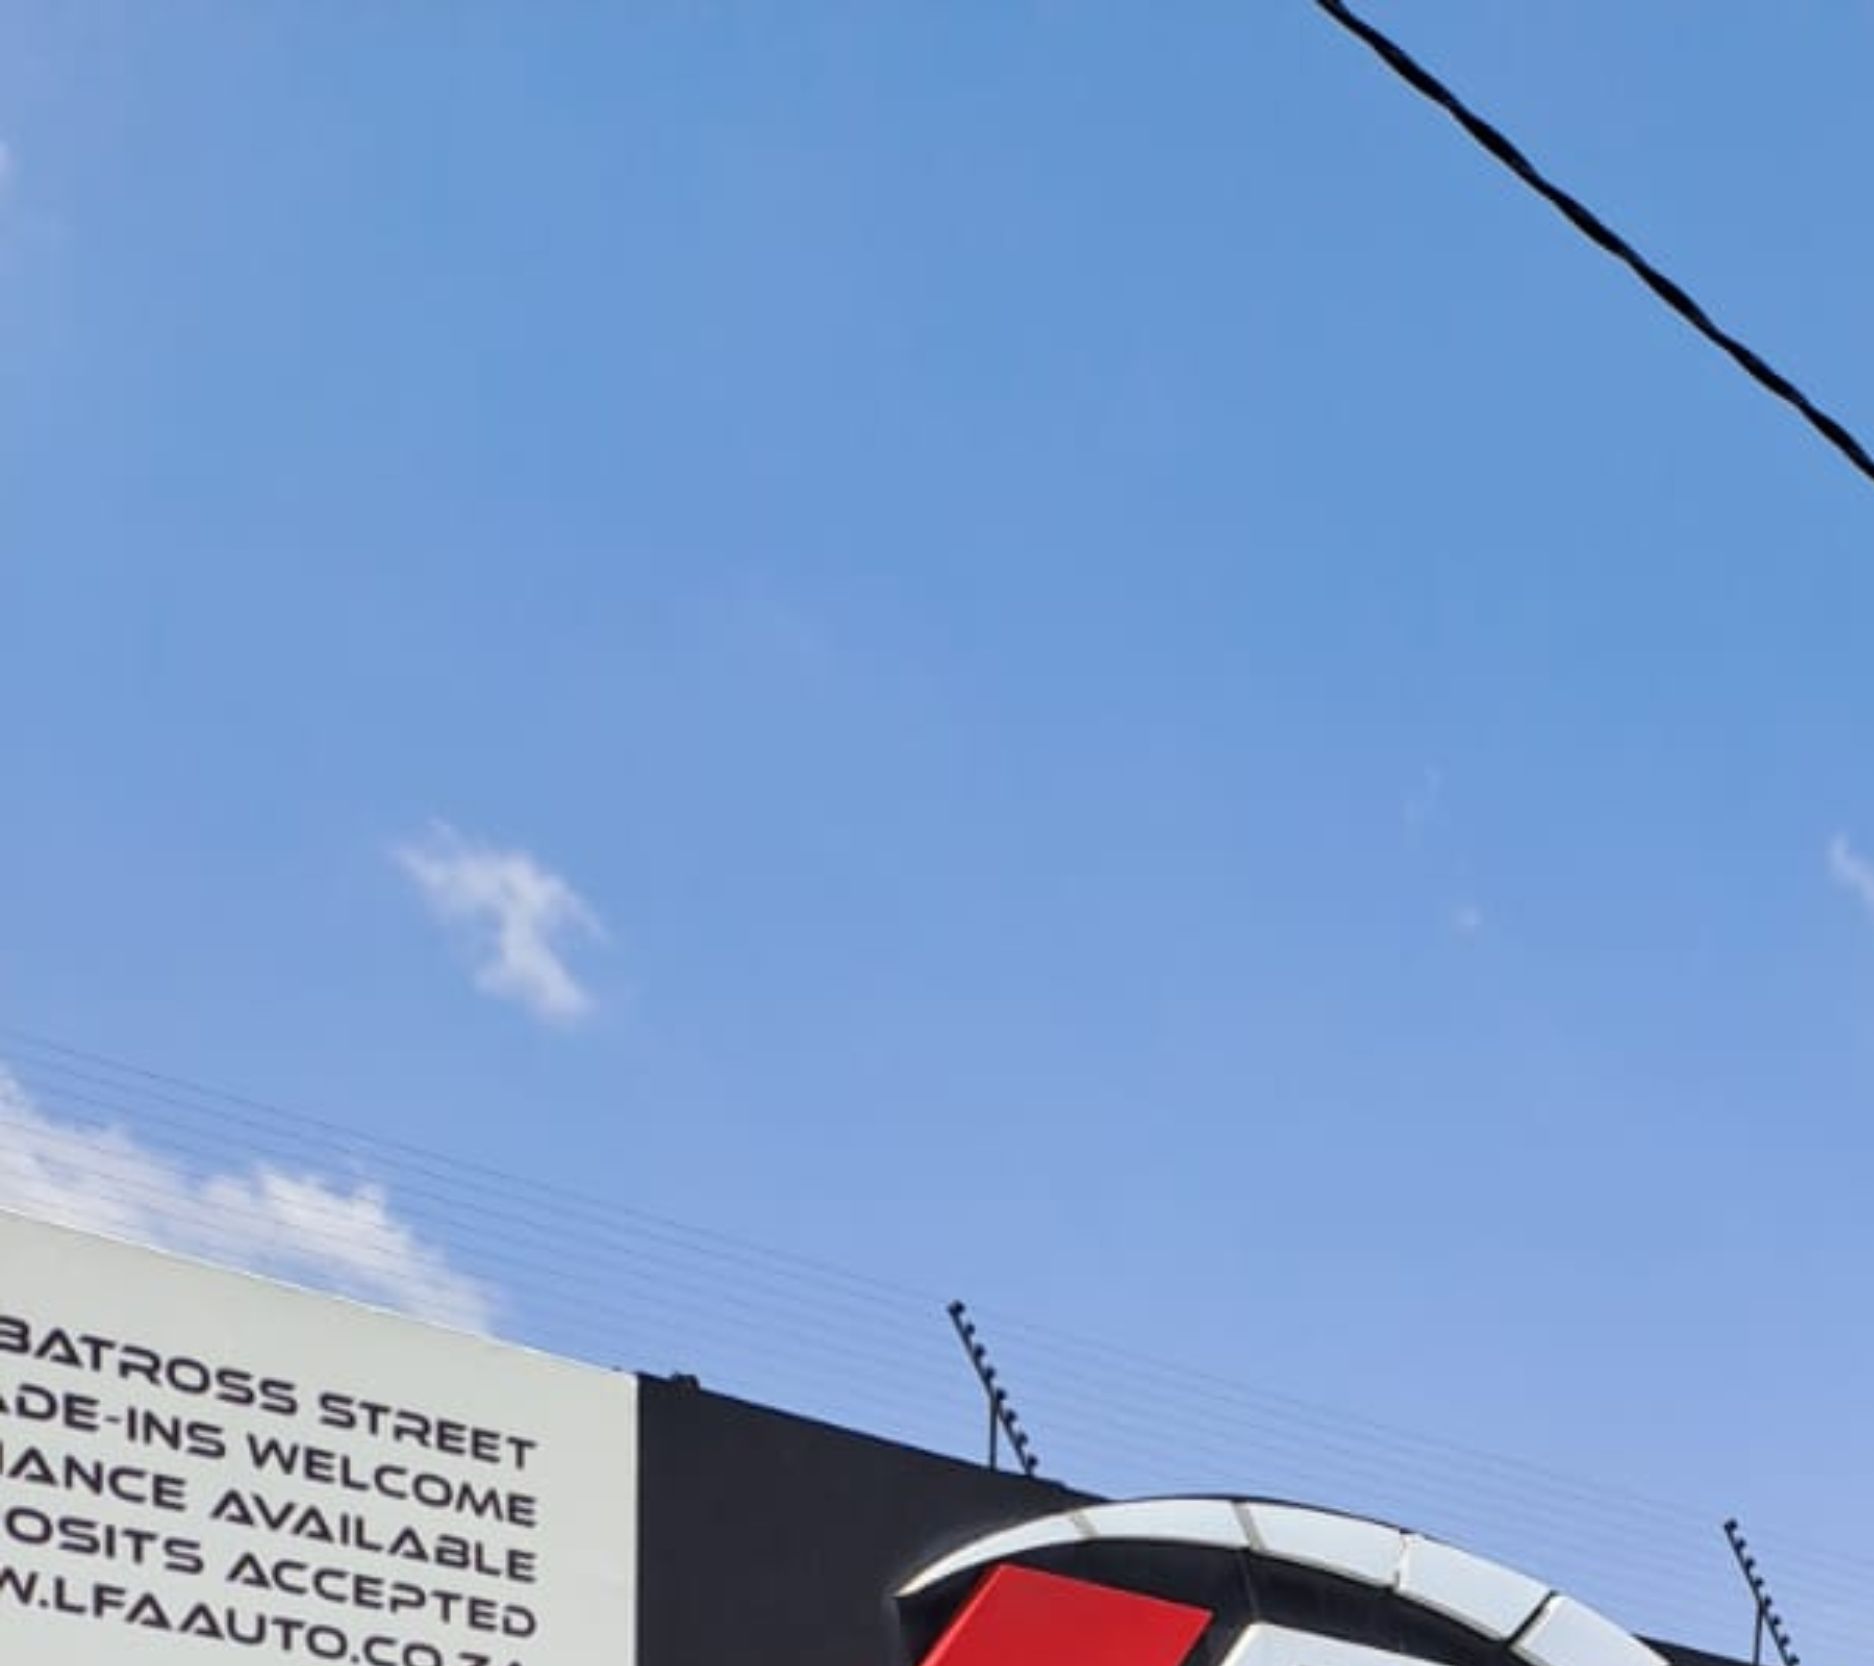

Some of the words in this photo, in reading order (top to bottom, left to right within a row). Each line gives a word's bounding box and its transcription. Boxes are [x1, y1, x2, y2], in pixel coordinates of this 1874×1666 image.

[0, 1383, 226, 1459] DE-INS
[247, 1433, 538, 1528] WELCOME
[319, 1392, 538, 1469] STREET
[0, 1438, 187, 1512] ANCE
[210, 1489, 537, 1583] AVAILABLE
[226, 1552, 537, 1638] ACCEPTED
